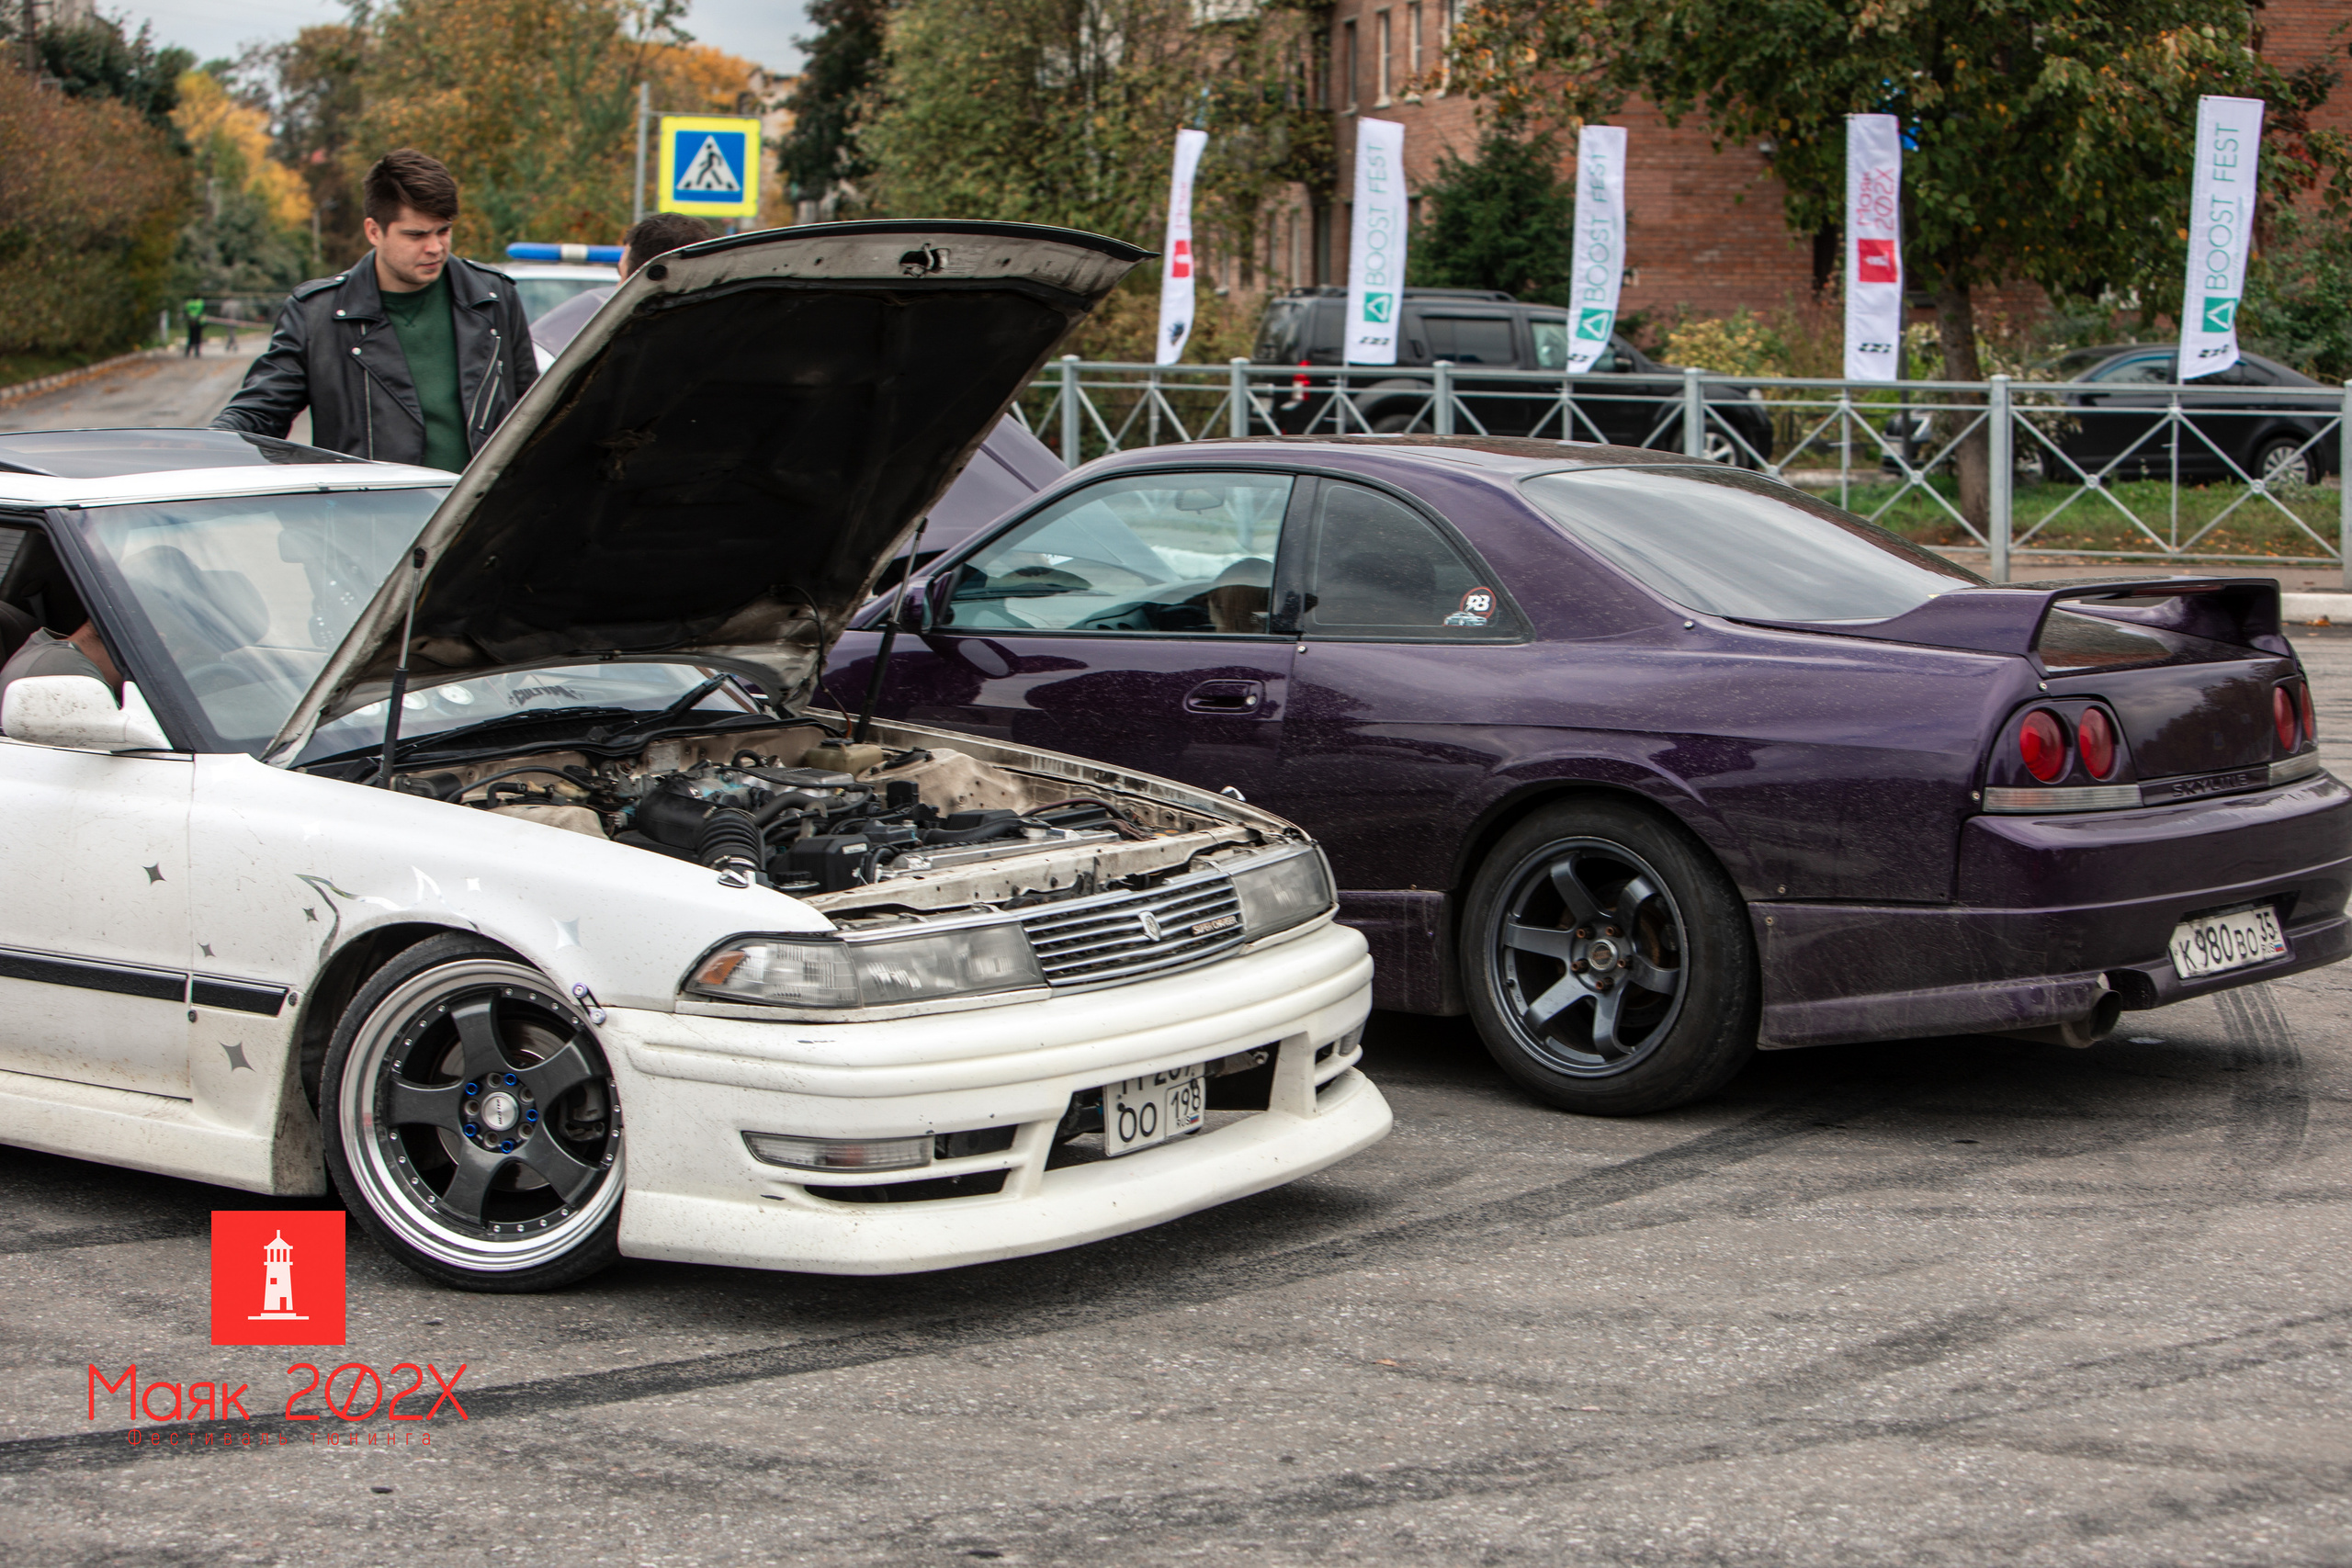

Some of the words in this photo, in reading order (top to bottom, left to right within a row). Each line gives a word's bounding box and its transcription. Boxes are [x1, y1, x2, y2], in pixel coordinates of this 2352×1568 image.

[1367, 142, 1388, 195] FEST
[2212, 122, 2239, 182] FEST
[1589, 153, 1609, 203] FEST
[1856, 171, 1872, 226] Маяк
[1363, 204, 1390, 287] BOOST
[1583, 215, 1610, 302] BOOST
[2204, 194, 2234, 290] BOOST
[2172, 774, 2248, 797] SKYLINE
[2256, 911, 2277, 942] 35
[2261, 942, 2276, 956] RUS
[1170, 1084, 1202, 1119] 198
[1176, 1114, 1192, 1130] RUS
